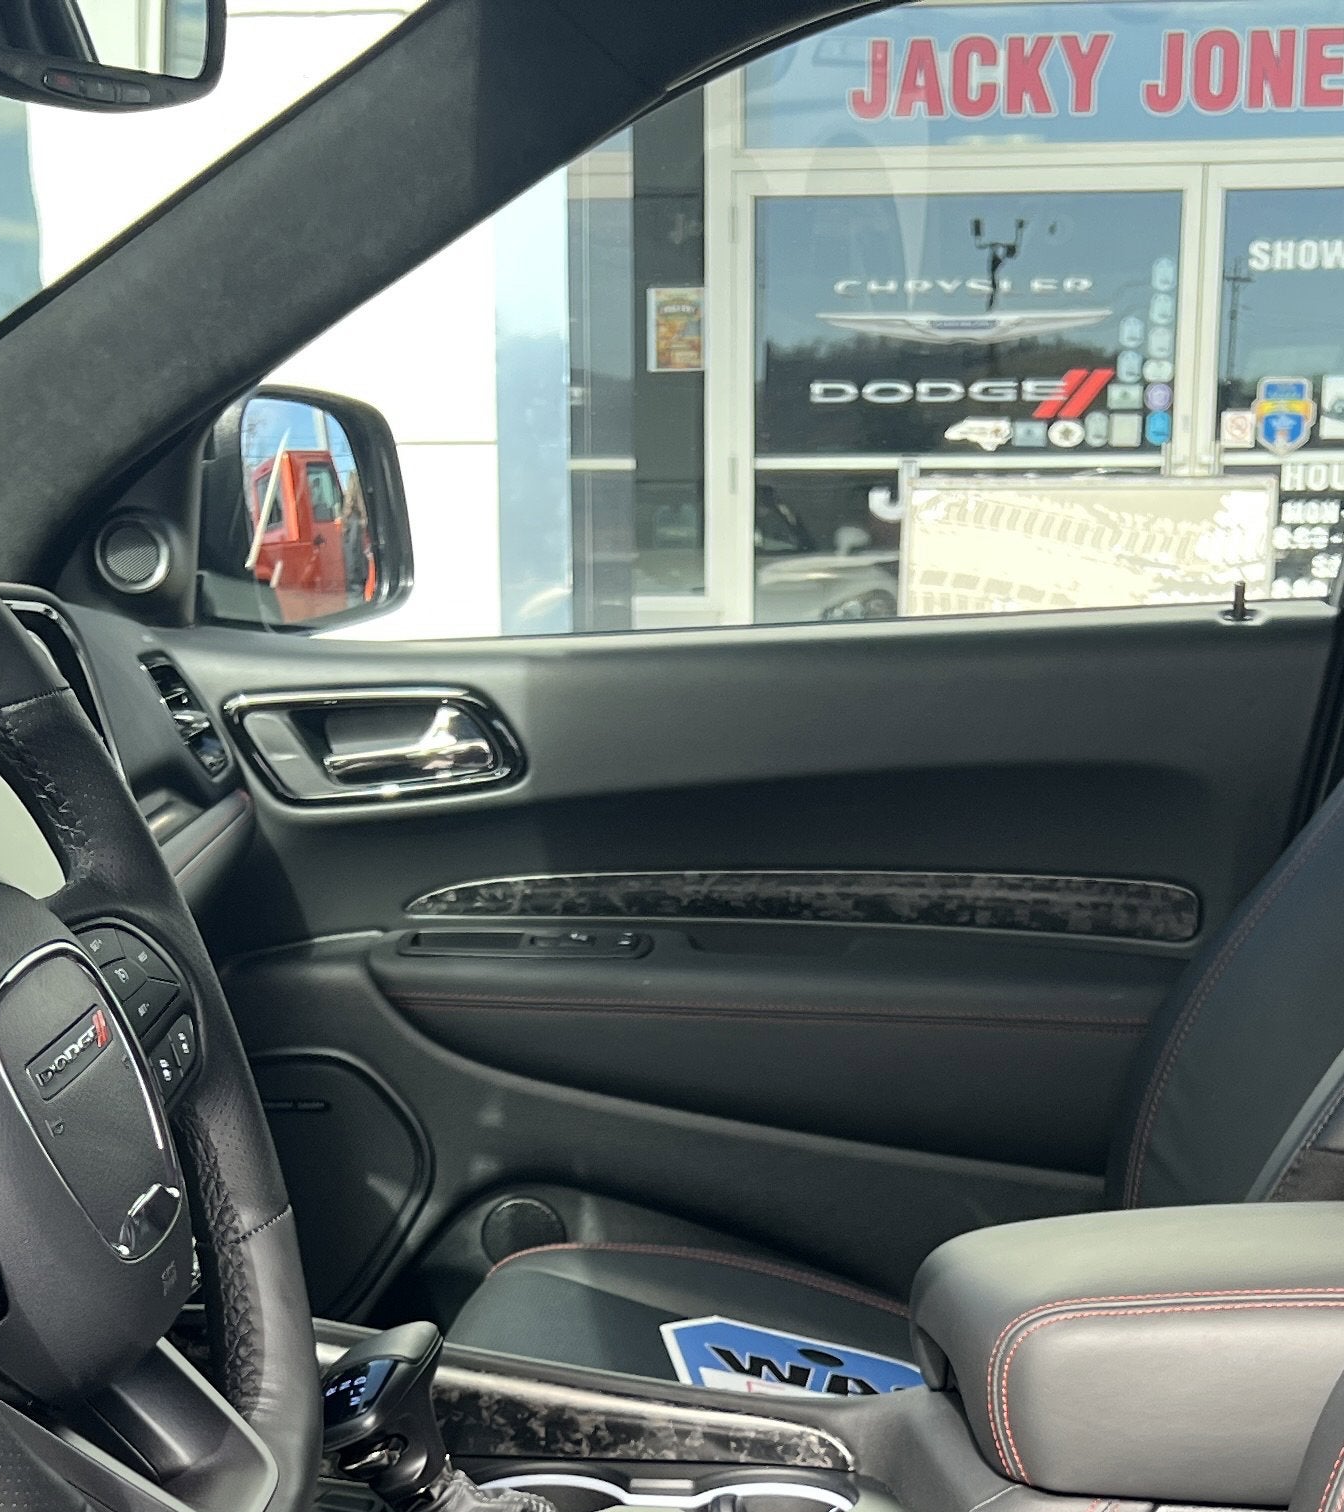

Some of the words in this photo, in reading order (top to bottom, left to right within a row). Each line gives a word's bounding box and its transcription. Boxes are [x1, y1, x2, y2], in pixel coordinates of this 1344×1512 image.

[850, 31, 1114, 119] JACKY
[833, 277, 1094, 294] CHRYSLER
[809, 379, 1069, 403] DODGE
